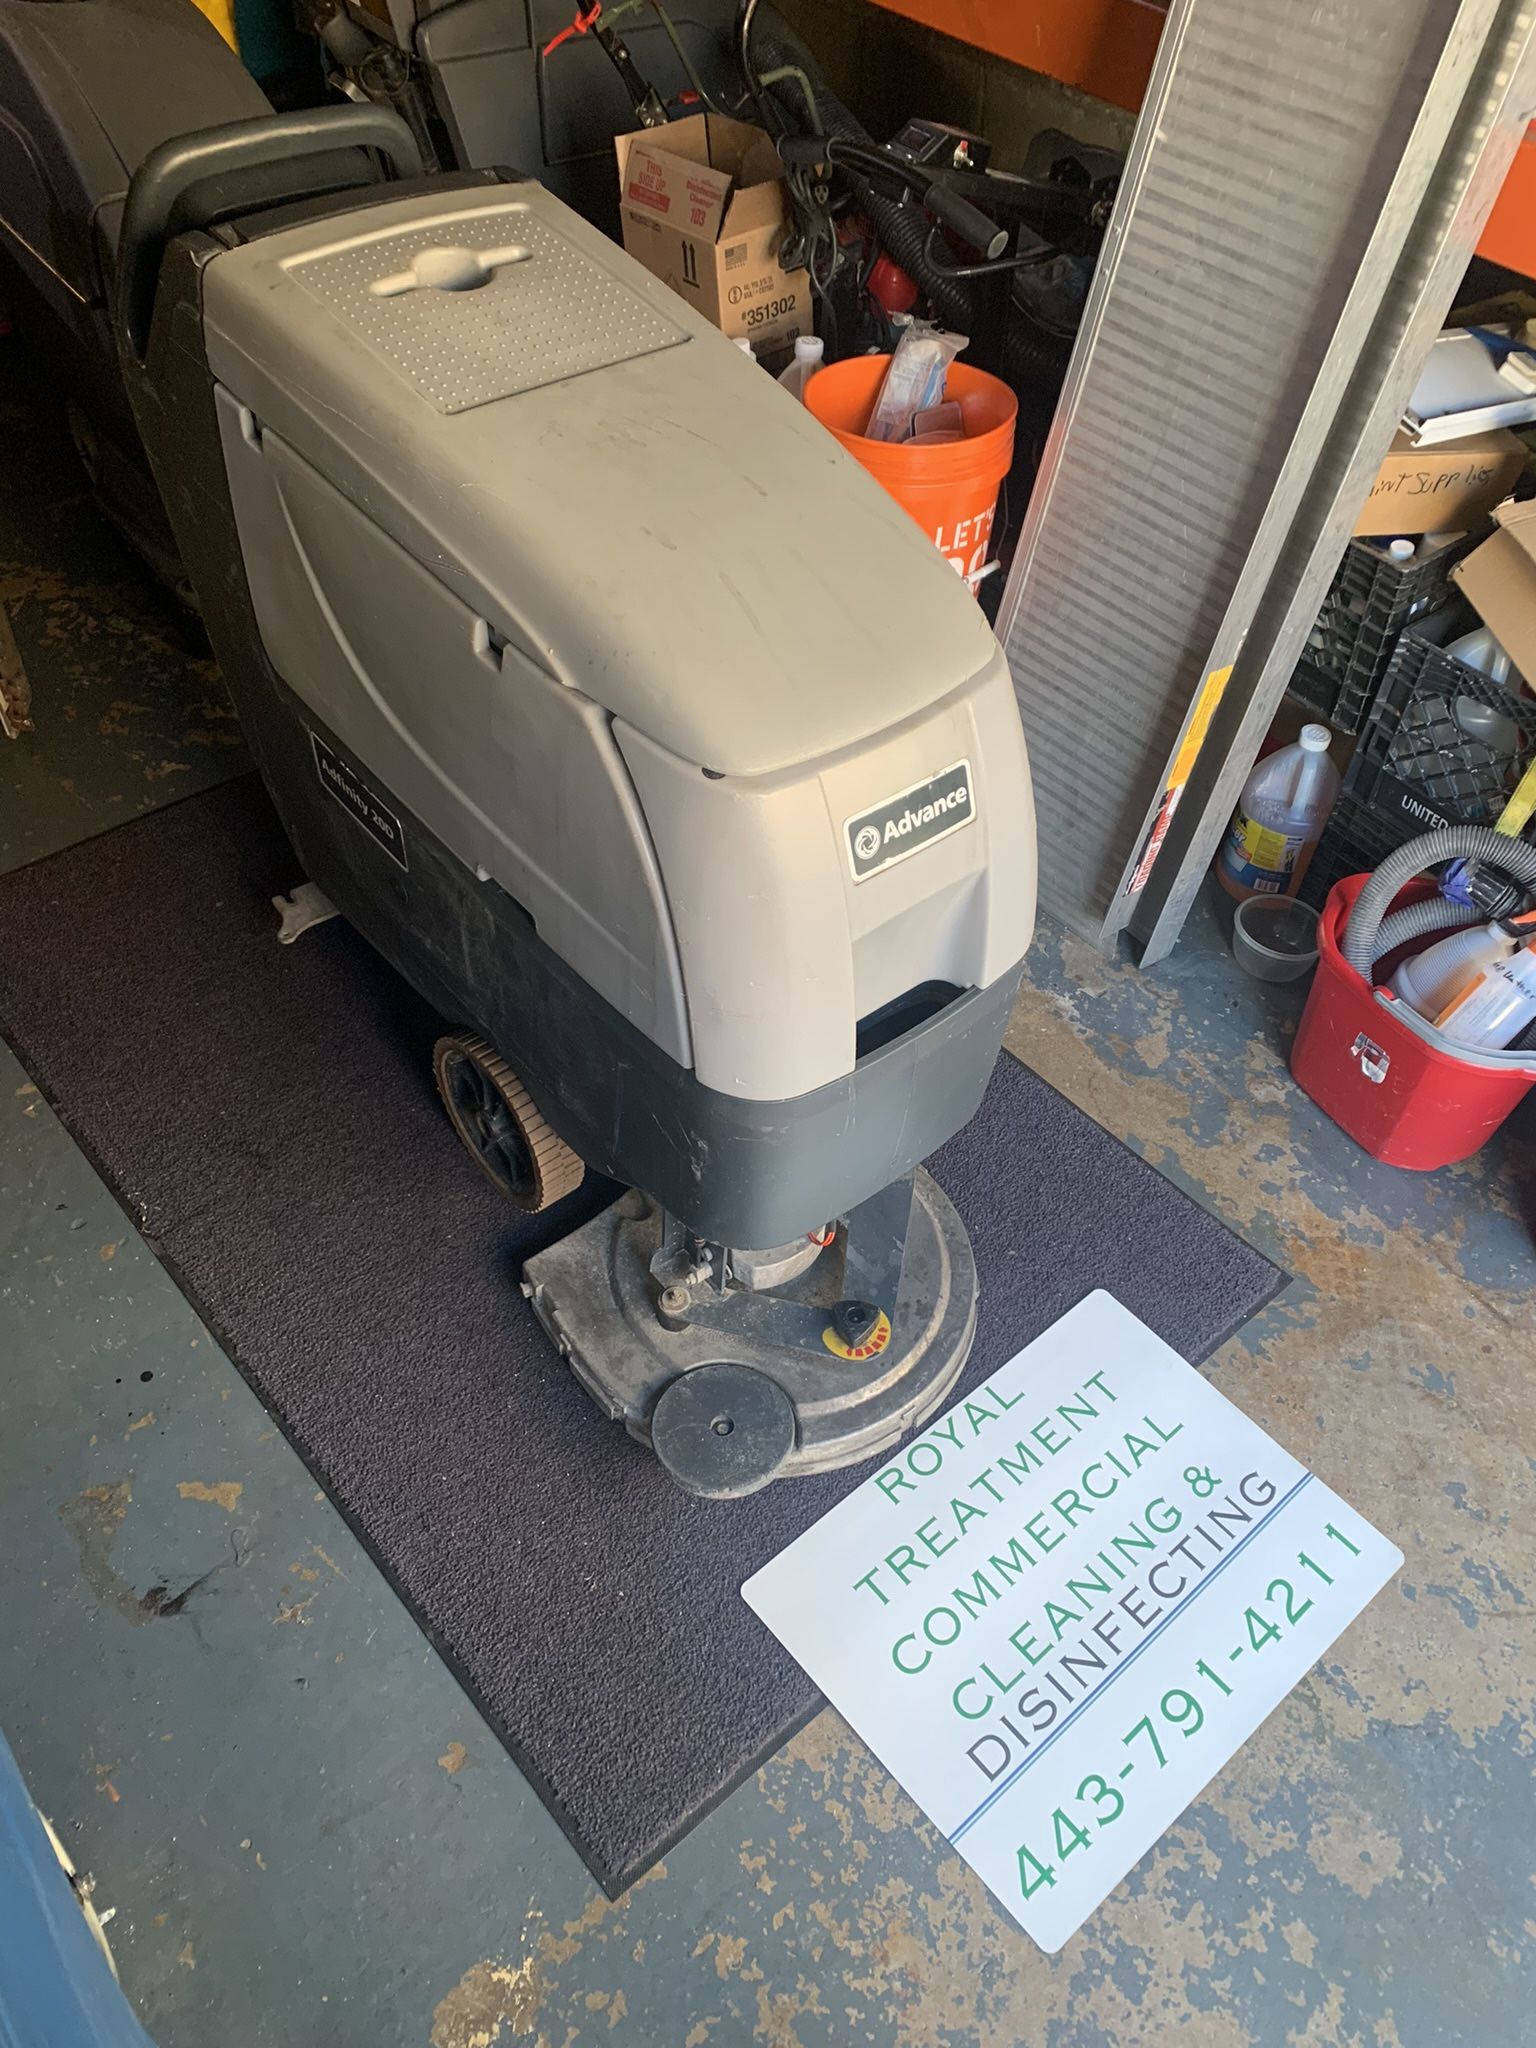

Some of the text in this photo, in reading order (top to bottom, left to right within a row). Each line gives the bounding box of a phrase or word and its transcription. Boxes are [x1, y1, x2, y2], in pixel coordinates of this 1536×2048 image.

[637, 170, 667, 192] SIDE UP
[645, 159, 663, 178] THIS
[690, 207, 706, 228] 103
[741, 294, 797, 327] #351302
[370, 808, 395, 840] 20D
[883, 786, 968, 845] Advance
[1401, 794, 1450, 831] UNITED
[875, 1384, 1026, 1506] ROYAL
[852, 1369, 1121, 1607] TREATMENT
[891, 1414, 1184, 1675] COMMERCIAL
[951, 1464, 1224, 1721] CLEANING &
[965, 1471, 1278, 1783] DISINFECTING
[1016, 1522, 1362, 1901] 443-791-4211
